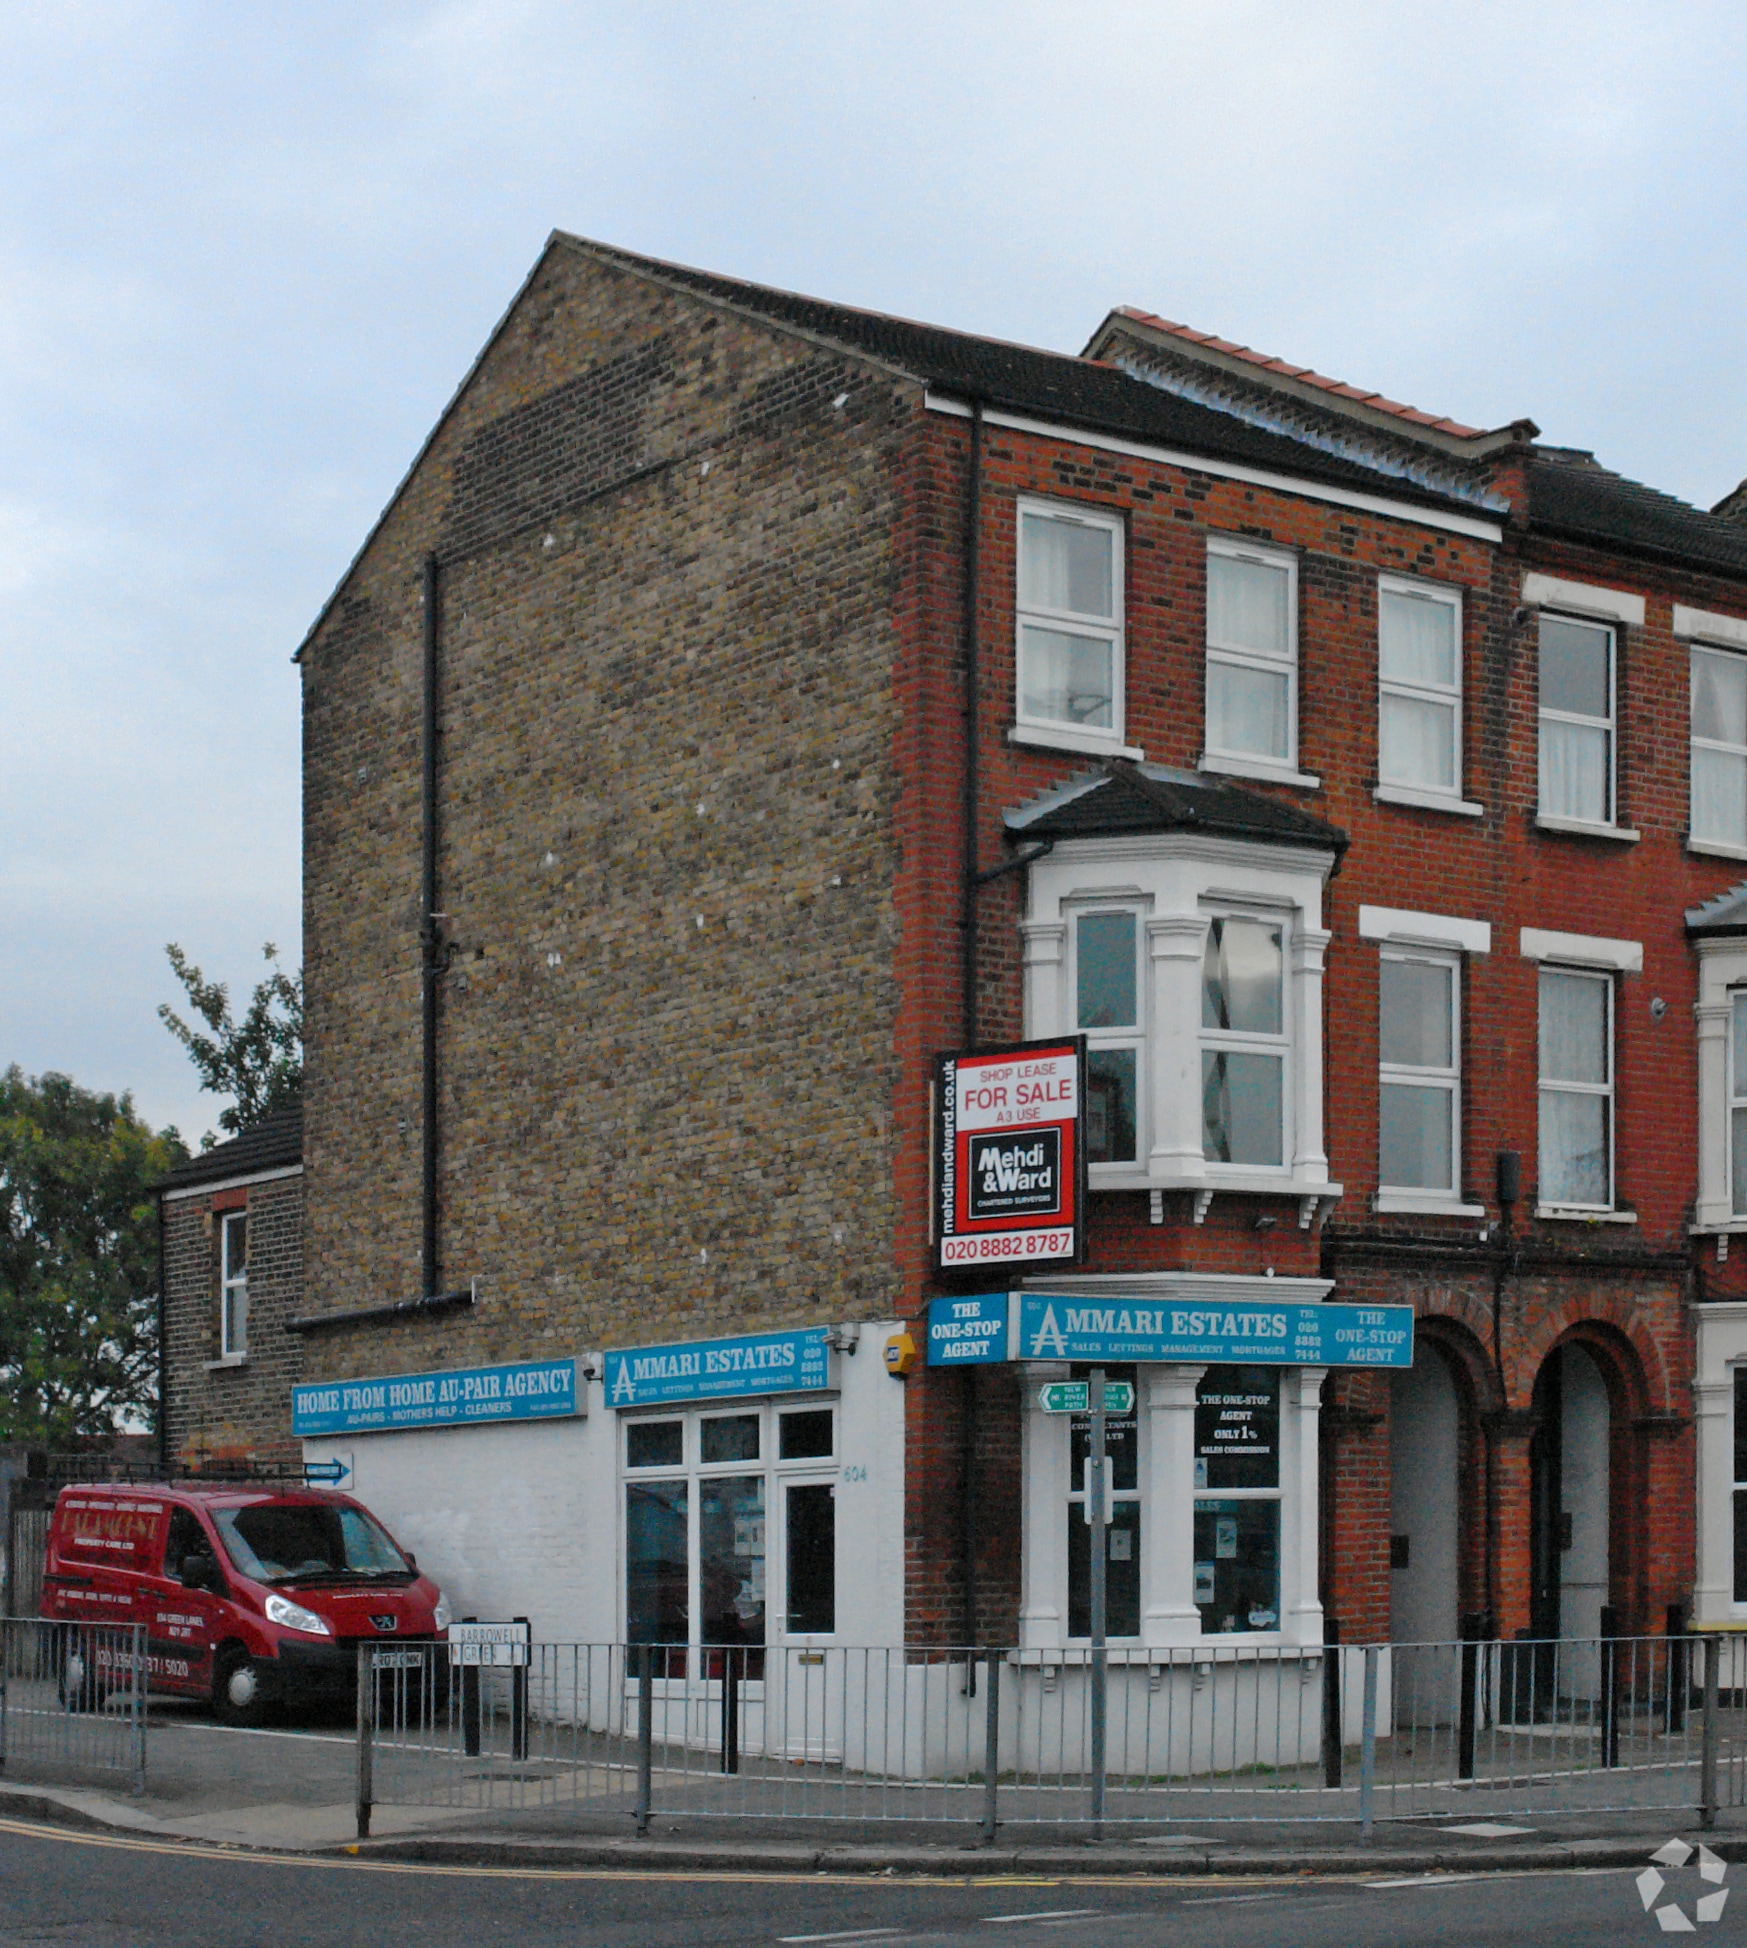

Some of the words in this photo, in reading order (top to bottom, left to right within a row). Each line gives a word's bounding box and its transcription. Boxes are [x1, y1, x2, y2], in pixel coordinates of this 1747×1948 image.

[980, 1067, 1013, 1083] SHOP
[1017, 1062, 1057, 1079] LEASE
[965, 1086, 1007, 1111] FOR
[1016, 1079, 1072, 1105] SALE
[996, 1110, 1013, 1123] A3
[1017, 1107, 1041, 1121] USE
[942, 1059, 955, 1234] mehdiandward.co.uk
[978, 1143, 1044, 1171] Mehdi
[945, 1240, 977, 1260] 020
[980, 1236, 1022, 1257] 8882
[1026, 1233, 1071, 1254] 8787
[952, 1302, 981, 1318] THE
[1357, 1311, 1386, 1325] THE
[931, 1320, 1002, 1340] ONE-STOP
[1029, 1302, 1164, 1356] AMMARI
[1171, 1311, 1287, 1338] ESTATES
[1298, 1321, 1319, 1333] 020
[1295, 1335, 1321, 1347] 8882
[1335, 1328, 1407, 1344] ONE-STOP
[942, 1341, 990, 1358] AGENT
[1072, 1341, 1102, 1352] SALES
[1108, 1343, 1154, 1353] LETTINGS
[1161, 1343, 1224, 1355] MANAGEMENT
[1231, 1345, 1286, 1355] MORTGAGES
[1346, 1347, 1395, 1362] AGENT
[611, 1352, 700, 1403] AMMARI
[705, 1343, 795, 1373] ESTATES
[298, 1390, 339, 1414] HOME
[343, 1386, 386, 1410] FROM
[389, 1381, 435, 1406] HOME
[439, 1375, 501, 1402] AU-PAIR
[504, 1368, 571, 1397] AGENCY
[1201, 1395, 1221, 1405] THE
[1222, 1395, 1271, 1405] ONE-STOP
[347, 1411, 386, 1424] AU-PAIRS
[392, 1407, 433, 1421] MOTHERS
[435, 1405, 457, 1417] HELP
[465, 1402, 512, 1415] CLEANERS
[1220, 1411, 1253, 1420] AGENT
[1106, 1432, 1125, 1440] LTD
[1214, 1429, 1240, 1439] ONLY
[844, 1465, 867, 1482] 604
[461, 1628, 521, 1644] BARROWELL
[165, 1657, 189, 1678] 5020
